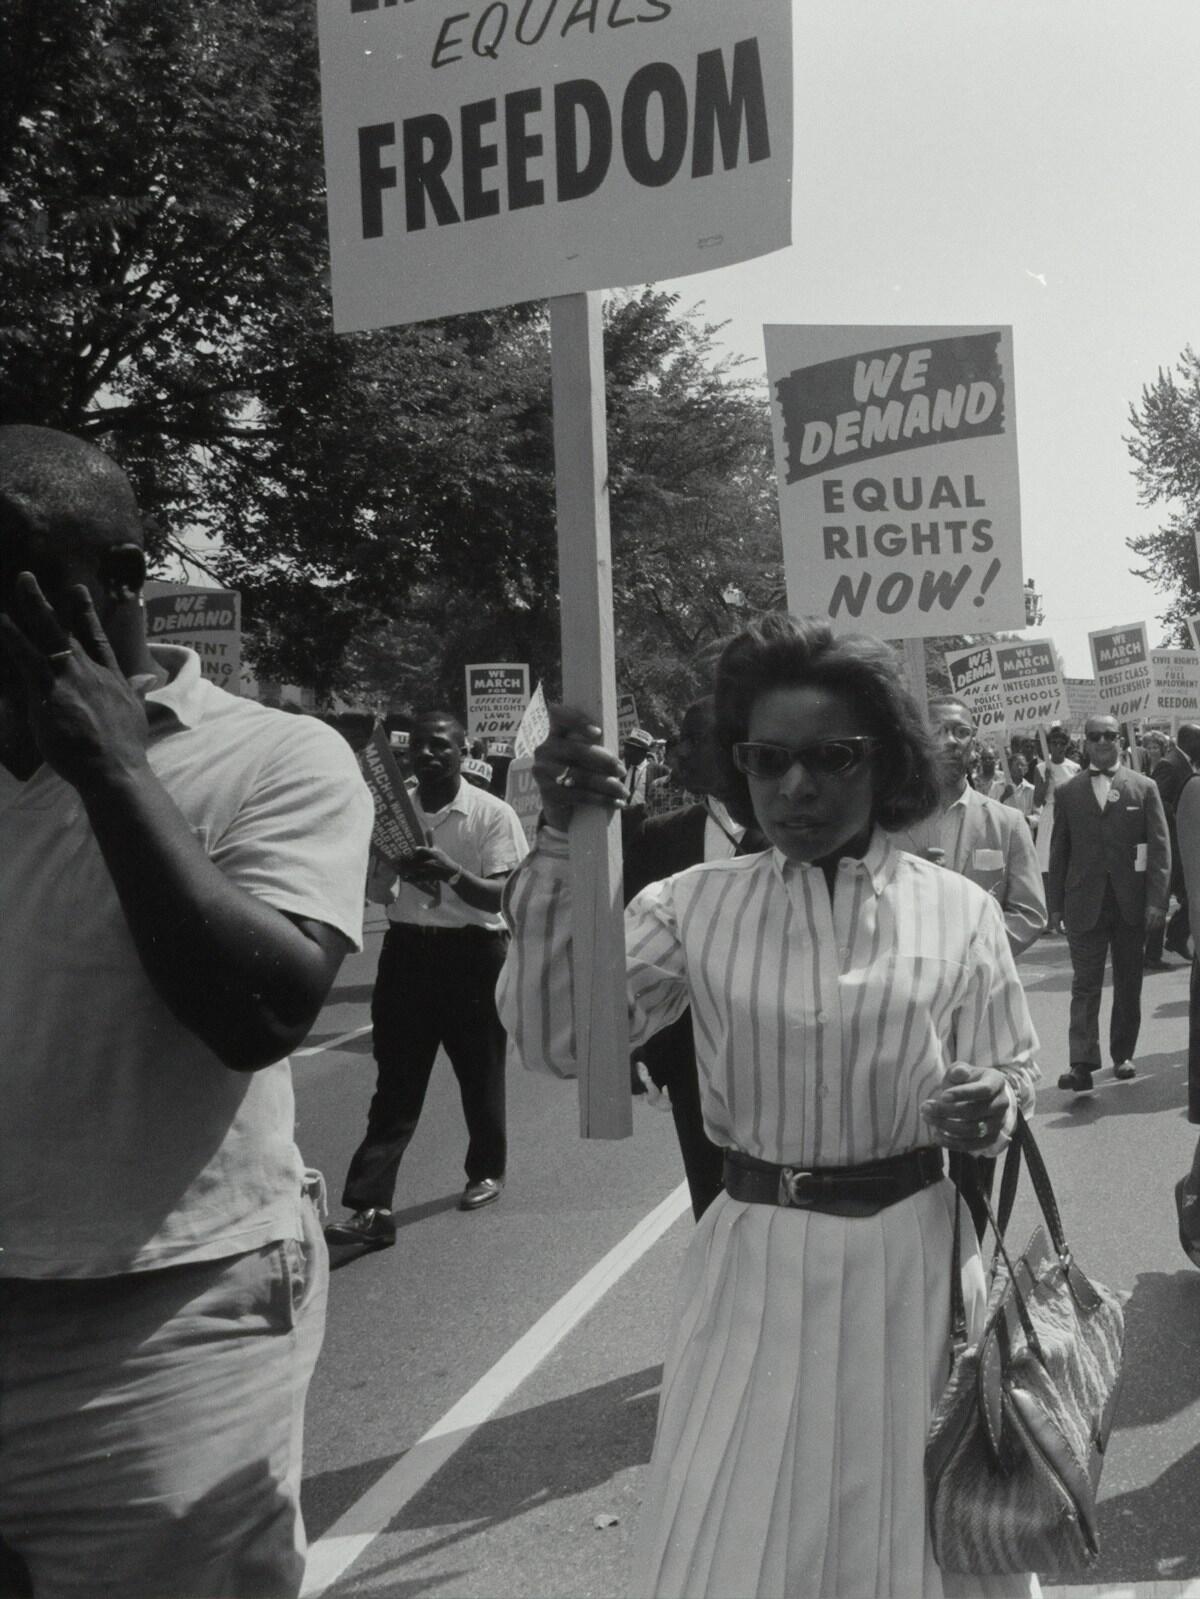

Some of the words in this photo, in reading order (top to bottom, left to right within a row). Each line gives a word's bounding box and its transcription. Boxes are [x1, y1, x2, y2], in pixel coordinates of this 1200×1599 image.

[358, 36, 770, 240] FREEDOM
[853, 349, 931, 403] WE
[800, 381, 997, 466] DEMAND
[822, 474, 986, 513] EQUAL
[822, 519, 993, 559] RIGHTS
[828, 557, 1001, 618] NOW!
[174, 596, 208, 612] WE
[152, 610, 232, 632] DEMAND
[1112, 634, 1127, 646] WE
[968, 650, 989, 668] WE
[1015, 648, 1033, 657] WE
[1100, 642, 1141, 661] MARCH
[1152, 656, 1170, 665] CIVIL
[1004, 655, 1049, 672] MARCH
[489, 670, 505, 678] WE
[957, 663, 995, 688] DEMA
[1003, 675, 1058, 692] INTEGRATED
[1100, 671, 1122, 686] FIRST
[1124, 666, 1149, 681] CLASS
[1165, 672, 1185, 680] FULL
[474, 679, 520, 689] MARCH
[964, 686, 980, 696] AN
[984, 683, 999, 693] EN
[1100, 679, 1151, 700] CITIZENSHIP
[475, 697, 522, 705] EFFECTIVE
[1007, 688, 1061, 706] SCHOOLS
[1110, 693, 1150, 716] NOW!
[1157, 696, 1198, 709] REEDOM
[1014, 701, 1060, 722] NOW!
[365, 742, 393, 794] MARCH
[383, 819, 414, 857] FREEDO
